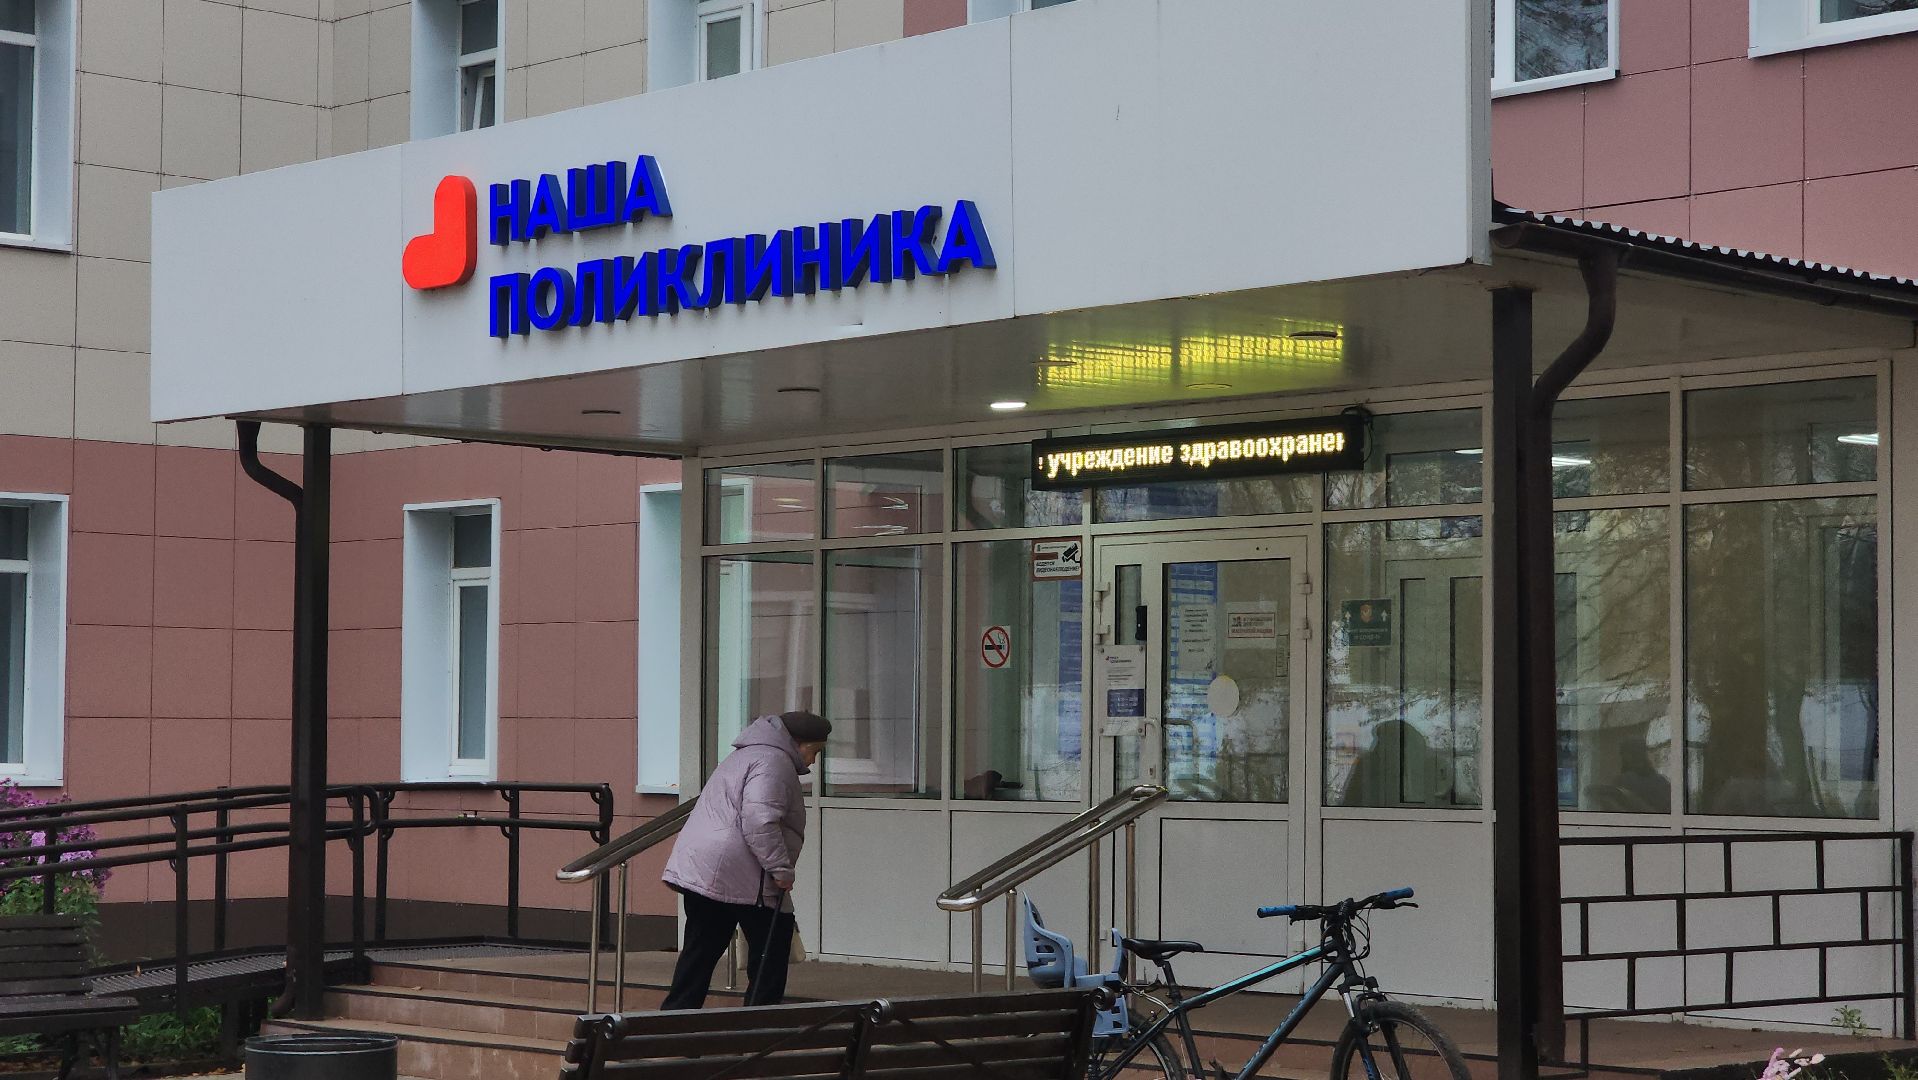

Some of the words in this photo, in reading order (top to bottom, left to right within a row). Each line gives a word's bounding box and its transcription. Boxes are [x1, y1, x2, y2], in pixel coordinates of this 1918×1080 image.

[489, 154, 673, 246] НАША
[489, 199, 997, 338] ПОЛИКЛИНИКА
[1047, 445, 1174, 479] учреждение
